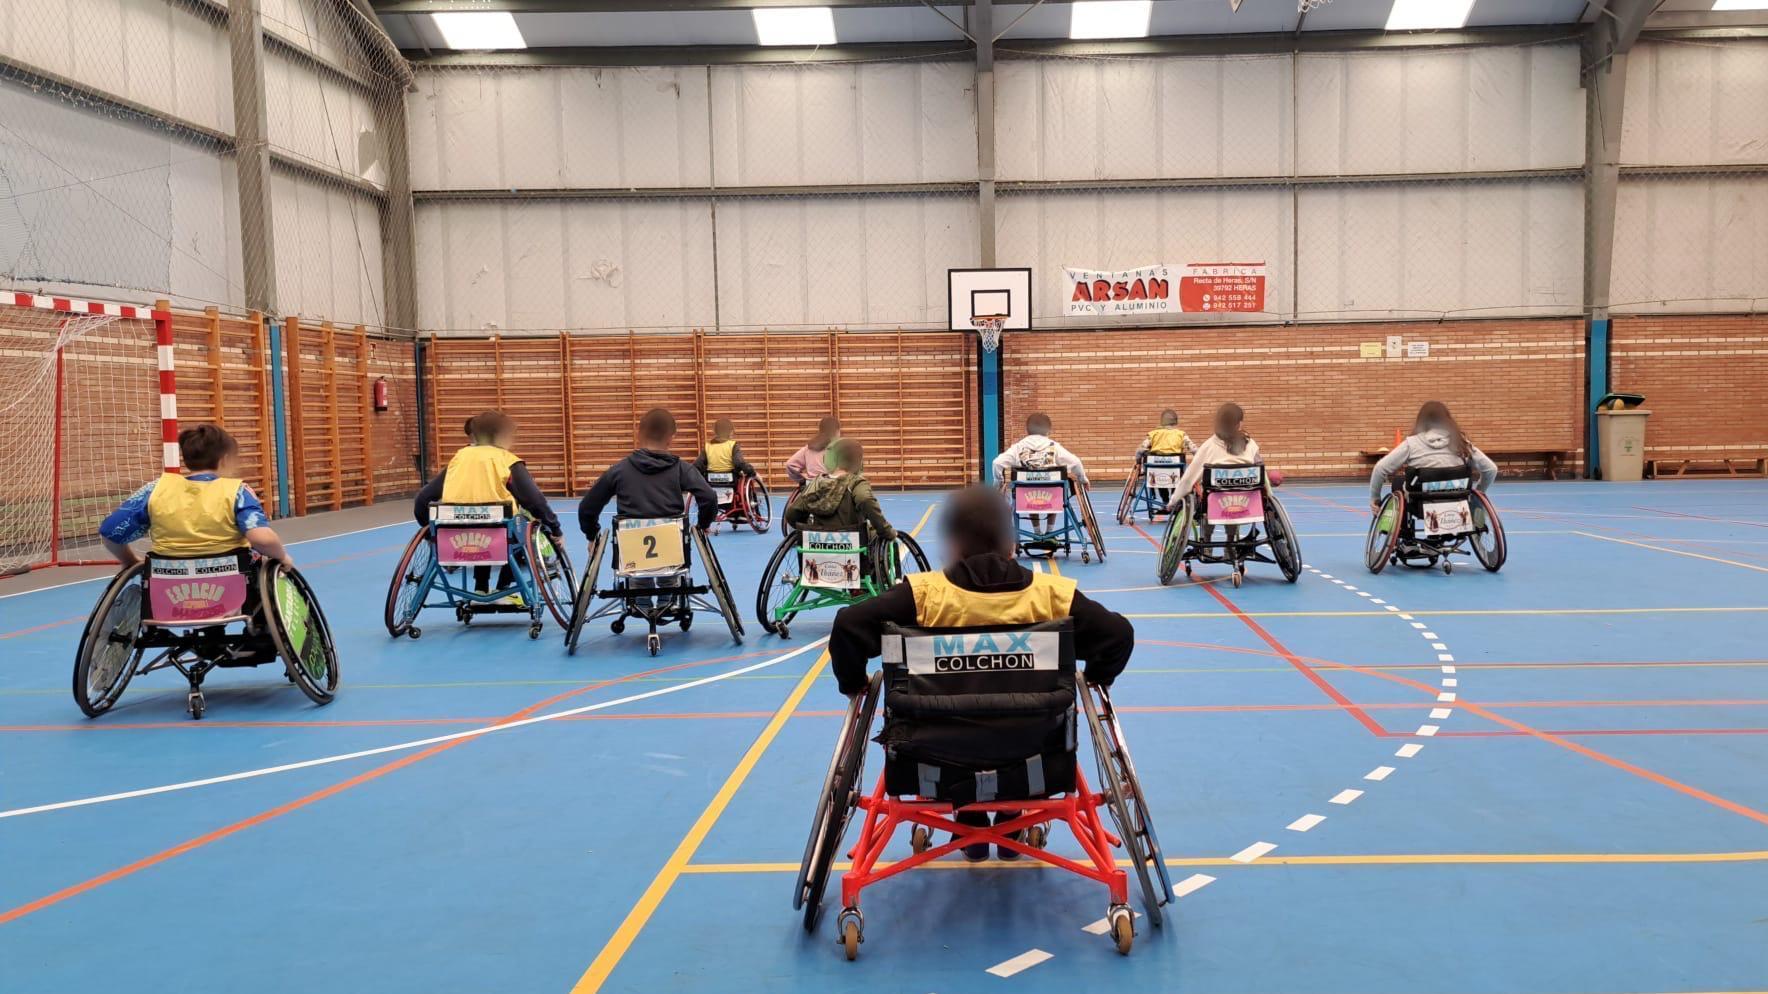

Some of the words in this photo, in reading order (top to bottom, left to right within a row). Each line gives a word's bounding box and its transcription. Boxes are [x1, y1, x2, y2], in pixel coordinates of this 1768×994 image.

[1193, 277, 1212, 285] Recta
[1072, 277, 1169, 302] ARSAN
[1071, 304, 1092, 312] PVC
[1099, 304, 1106, 312] Y
[1114, 301, 1168, 311] ALUMINIO
[1215, 468, 1257, 478] MAX
[1215, 477, 1257, 486] COLCHON
[454, 506, 488, 514] MAX
[808, 532, 850, 543] MAX
[643, 535, 658, 559] 2
[195, 565, 237, 574] COLCHON
[165, 583, 225, 604] ESPACIO
[933, 633, 1032, 655] MAX
[936, 654, 1034, 671] COLCHON
